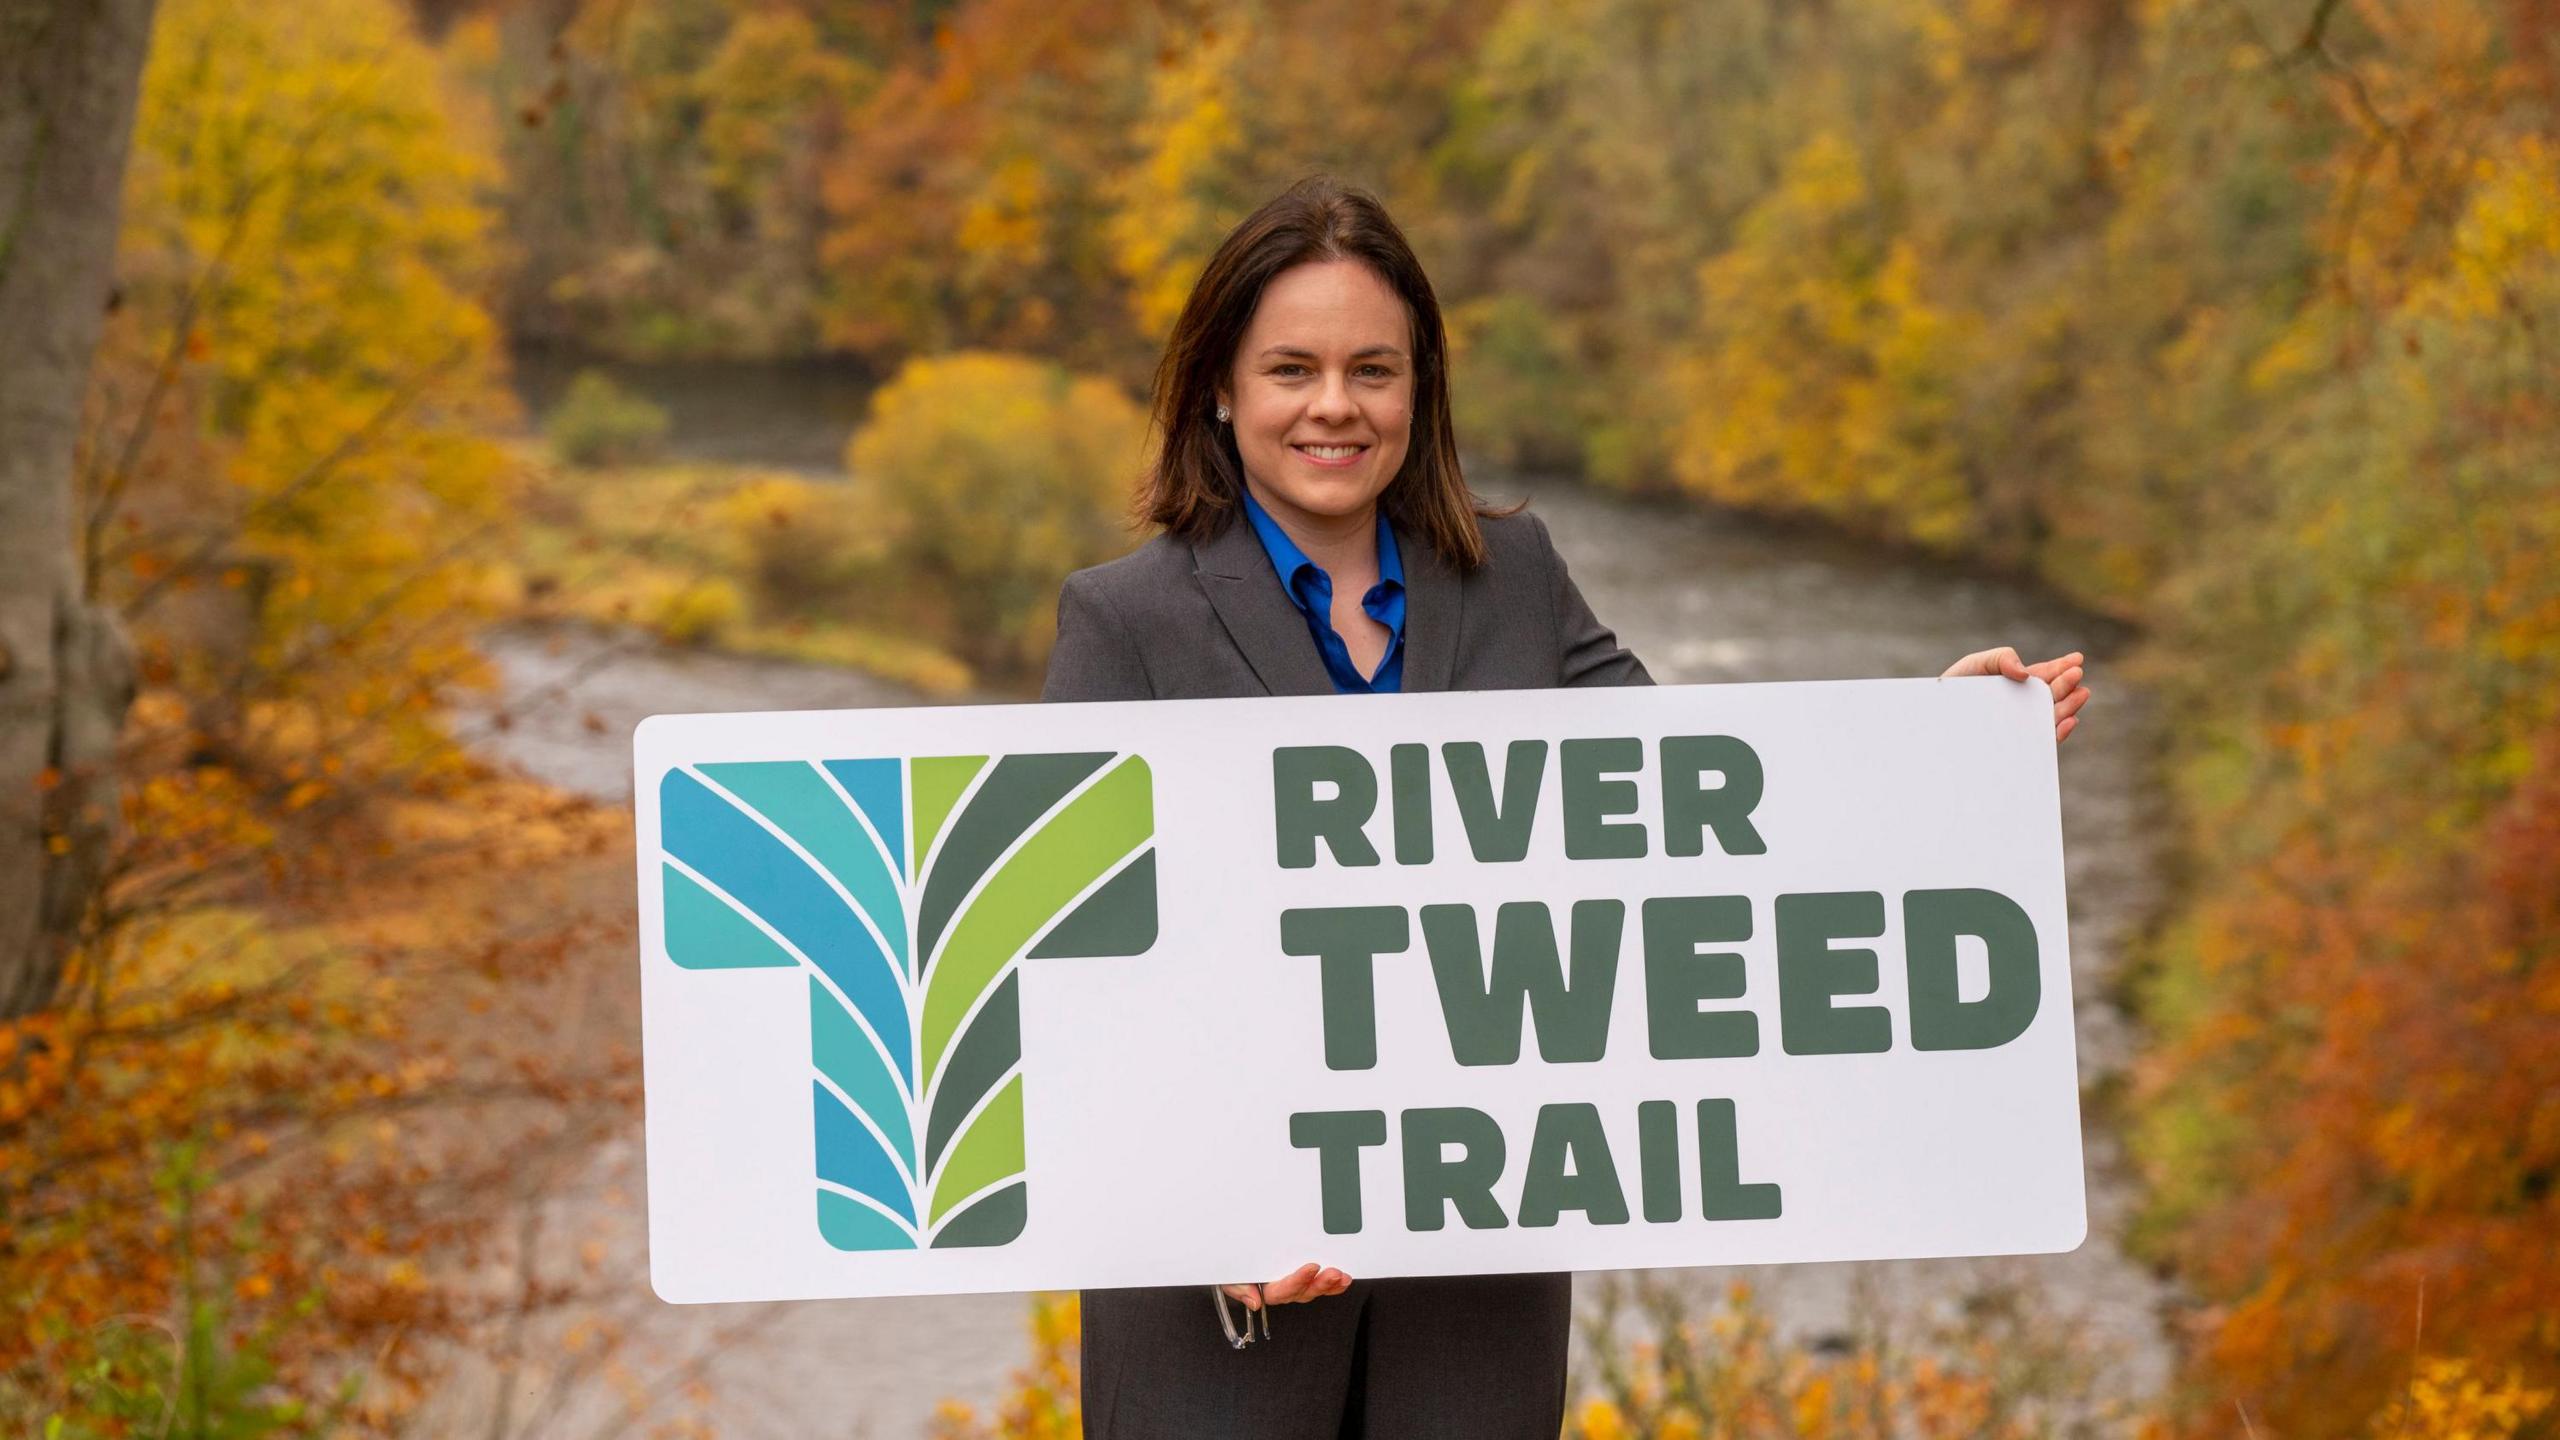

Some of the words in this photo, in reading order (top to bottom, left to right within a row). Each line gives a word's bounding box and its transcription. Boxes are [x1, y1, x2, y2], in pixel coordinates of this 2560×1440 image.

[1273, 735, 1767, 869] RIVER
[1280, 888, 2041, 1070] TWEED
[1290, 1098, 1782, 1234] TRAIL
